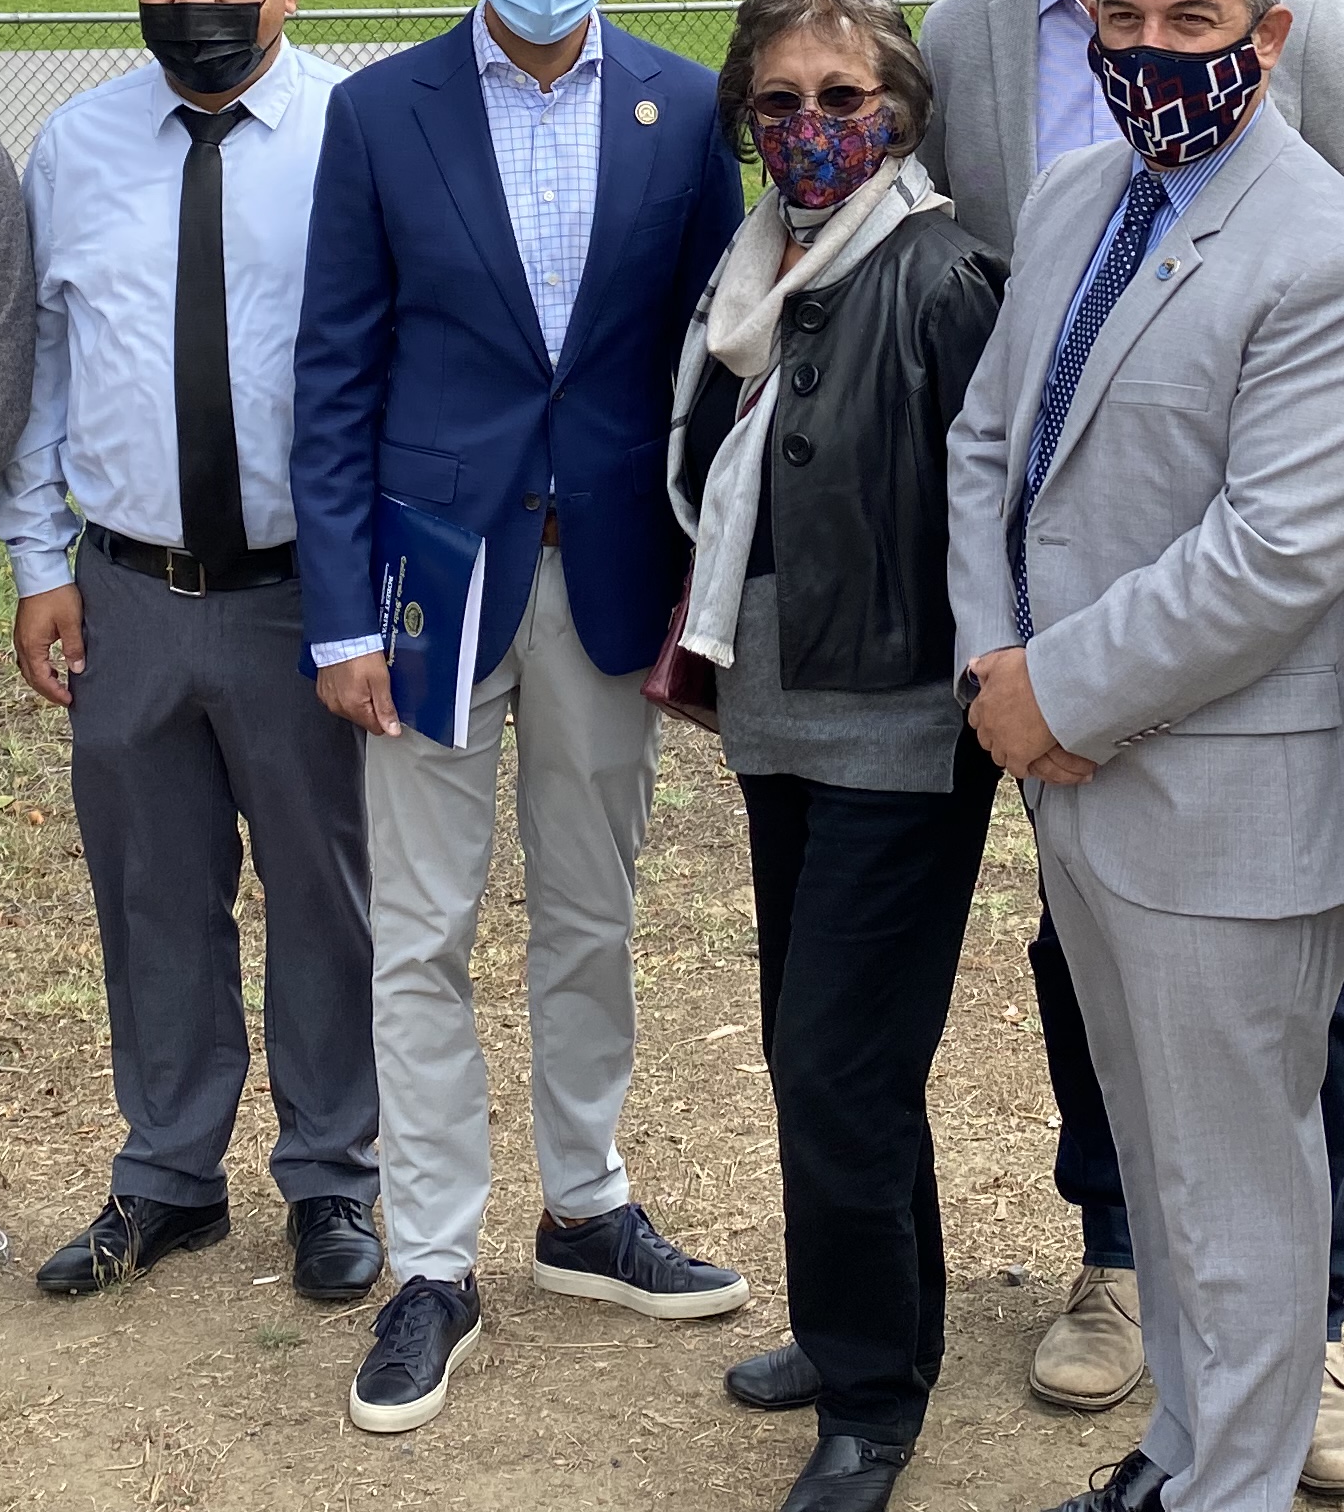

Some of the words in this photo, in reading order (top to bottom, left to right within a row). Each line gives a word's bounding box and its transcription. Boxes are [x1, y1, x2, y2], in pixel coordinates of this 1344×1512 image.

[384, 575, 394, 613] ROBERT
[396, 555, 407, 598] California
[393, 597, 403, 625] State
